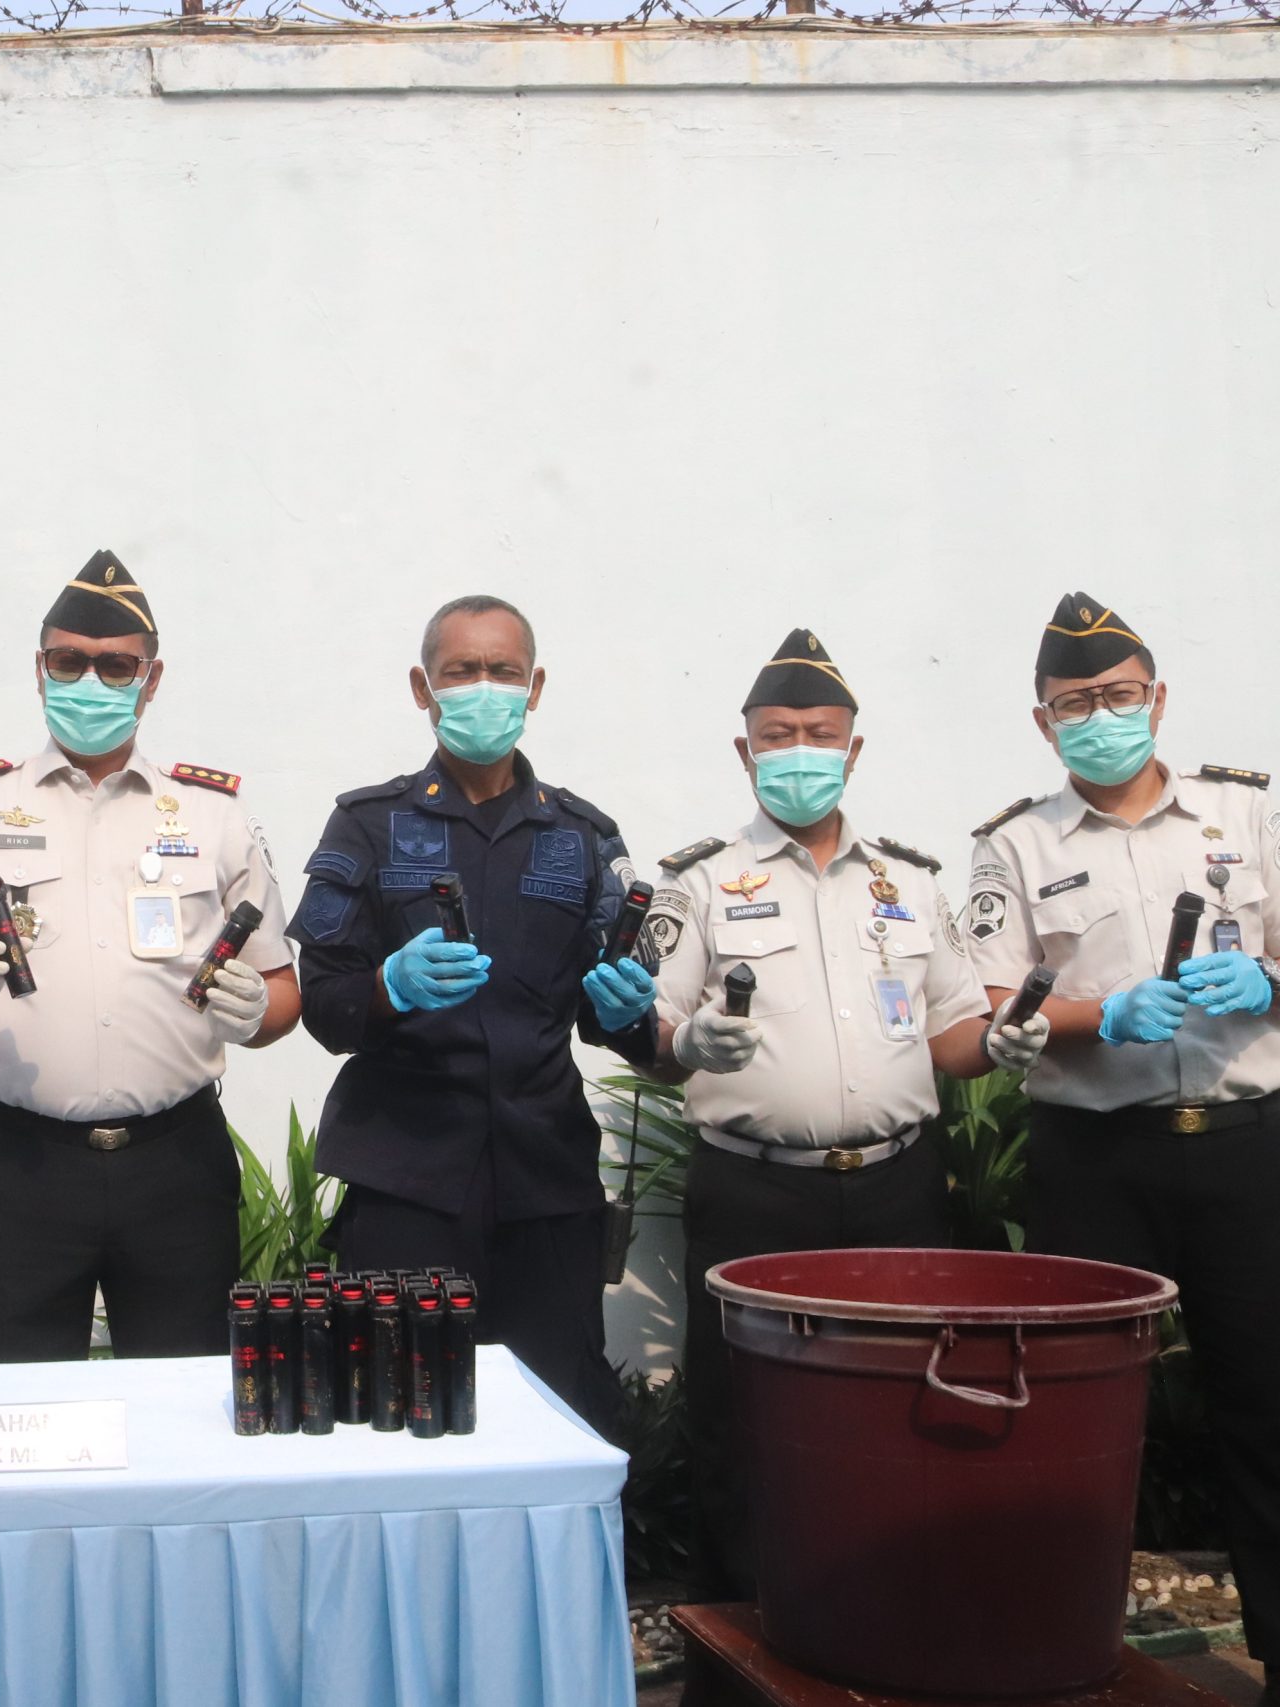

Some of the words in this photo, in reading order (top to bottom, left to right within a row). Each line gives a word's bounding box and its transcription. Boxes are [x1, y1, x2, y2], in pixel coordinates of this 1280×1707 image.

[6, 837, 29, 845] RIKO
[410, 873, 435, 886] ATM
[1050, 878, 1076, 893] AFRIZAL
[731, 904, 774, 917] DARMONO
